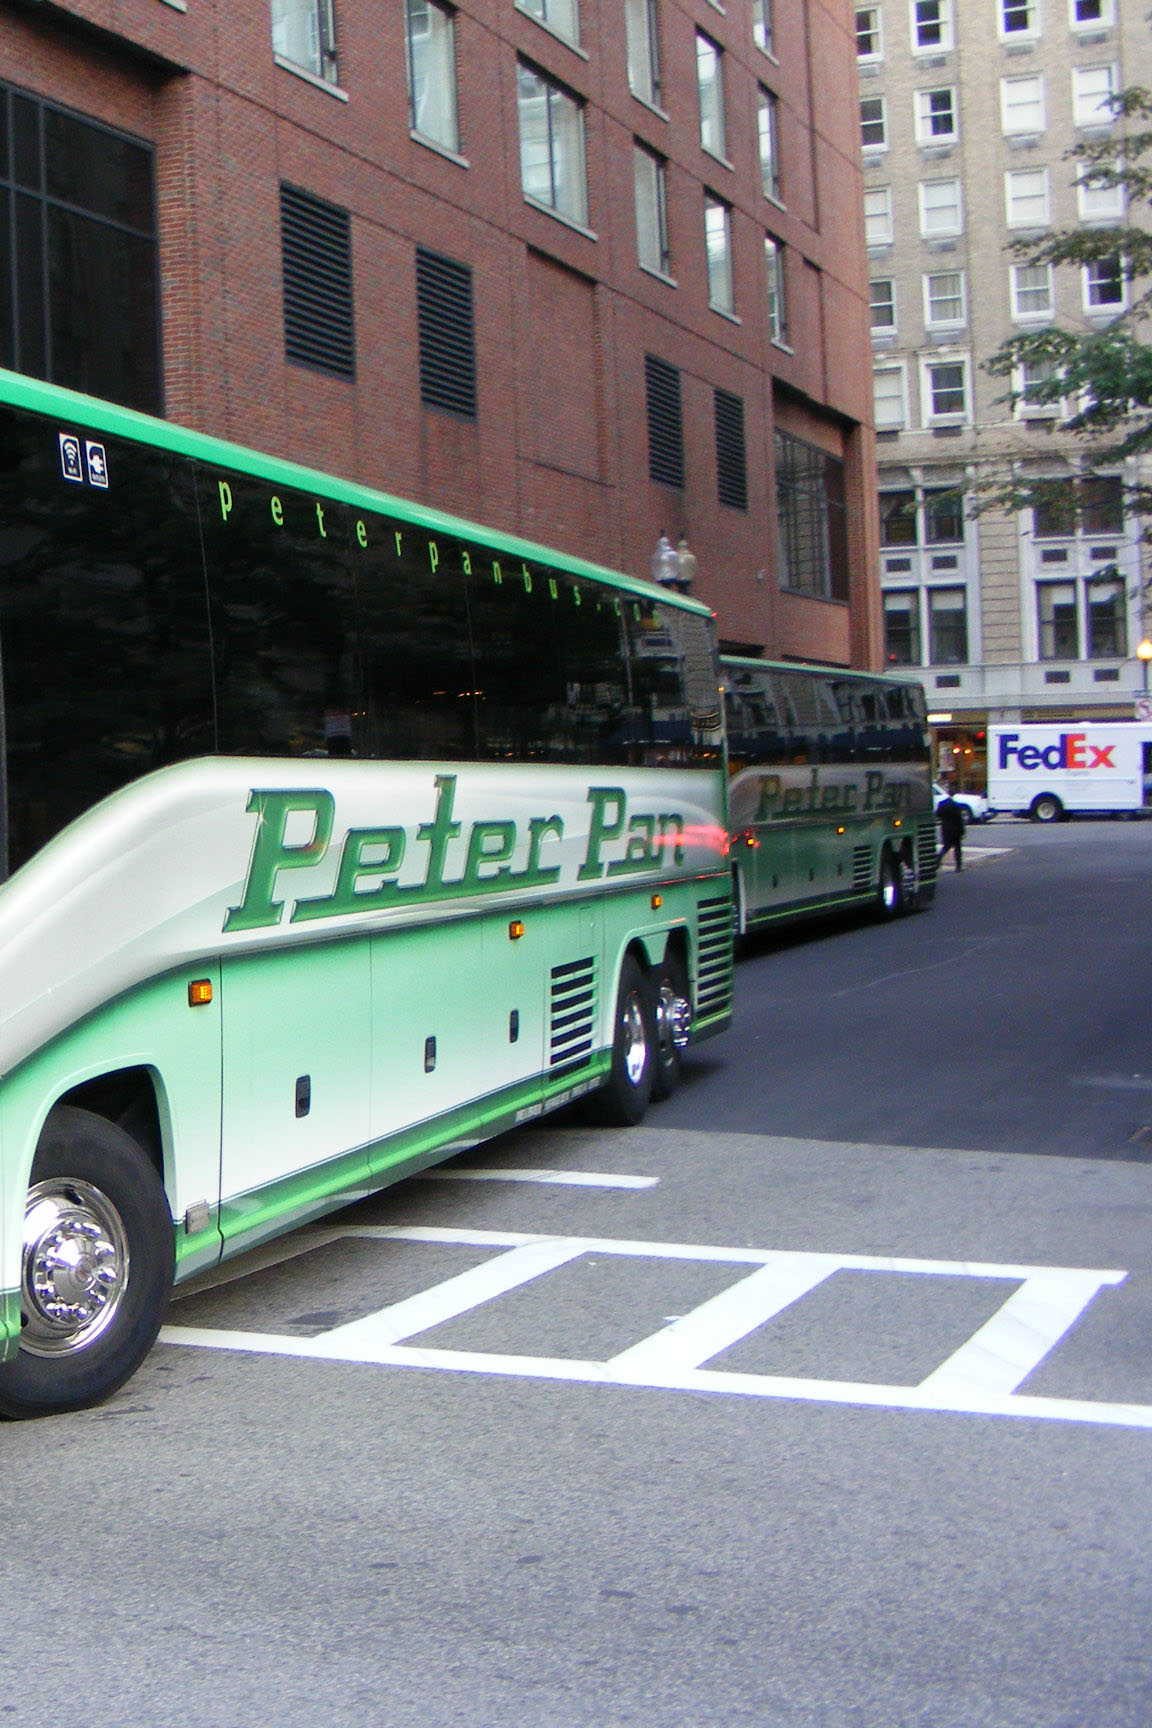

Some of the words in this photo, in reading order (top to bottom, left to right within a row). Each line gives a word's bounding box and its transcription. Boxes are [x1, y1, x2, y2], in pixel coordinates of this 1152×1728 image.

[998, 732, 1117, 771] FedEx
[222, 773, 565, 933] Peter
[577, 786, 685, 881] Pan
